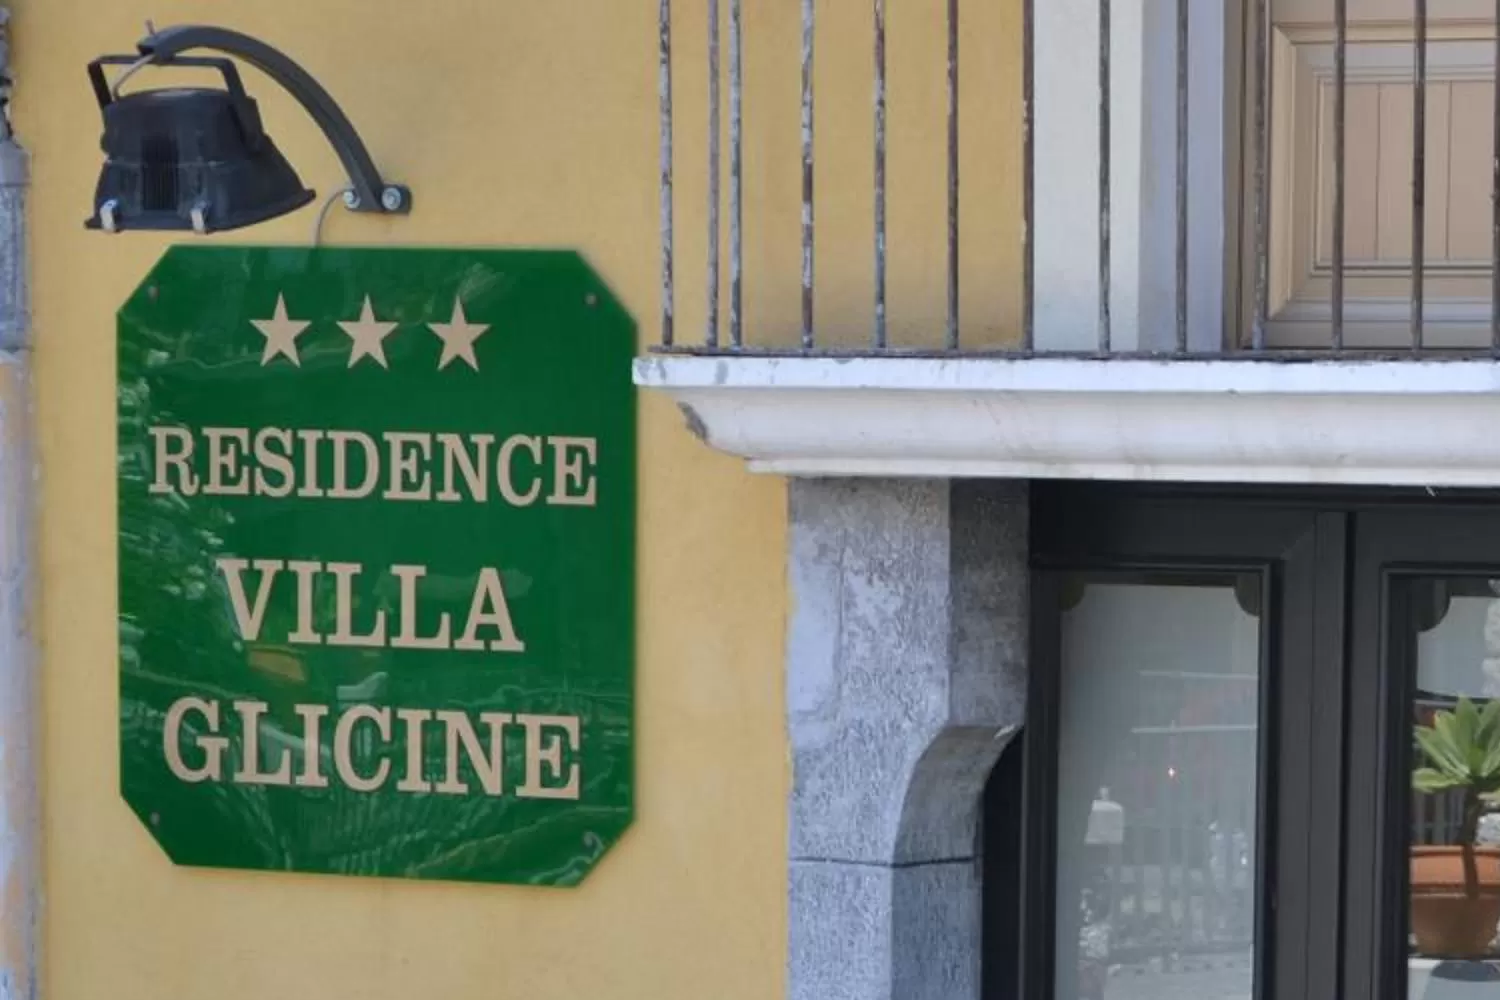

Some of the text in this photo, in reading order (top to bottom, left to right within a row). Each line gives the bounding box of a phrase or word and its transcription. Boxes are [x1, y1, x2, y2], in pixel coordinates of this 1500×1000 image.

[148, 425, 597, 507] RESIDENCE
[215, 558, 525, 653] VILLA
[162, 695, 582, 800] GLICINE
